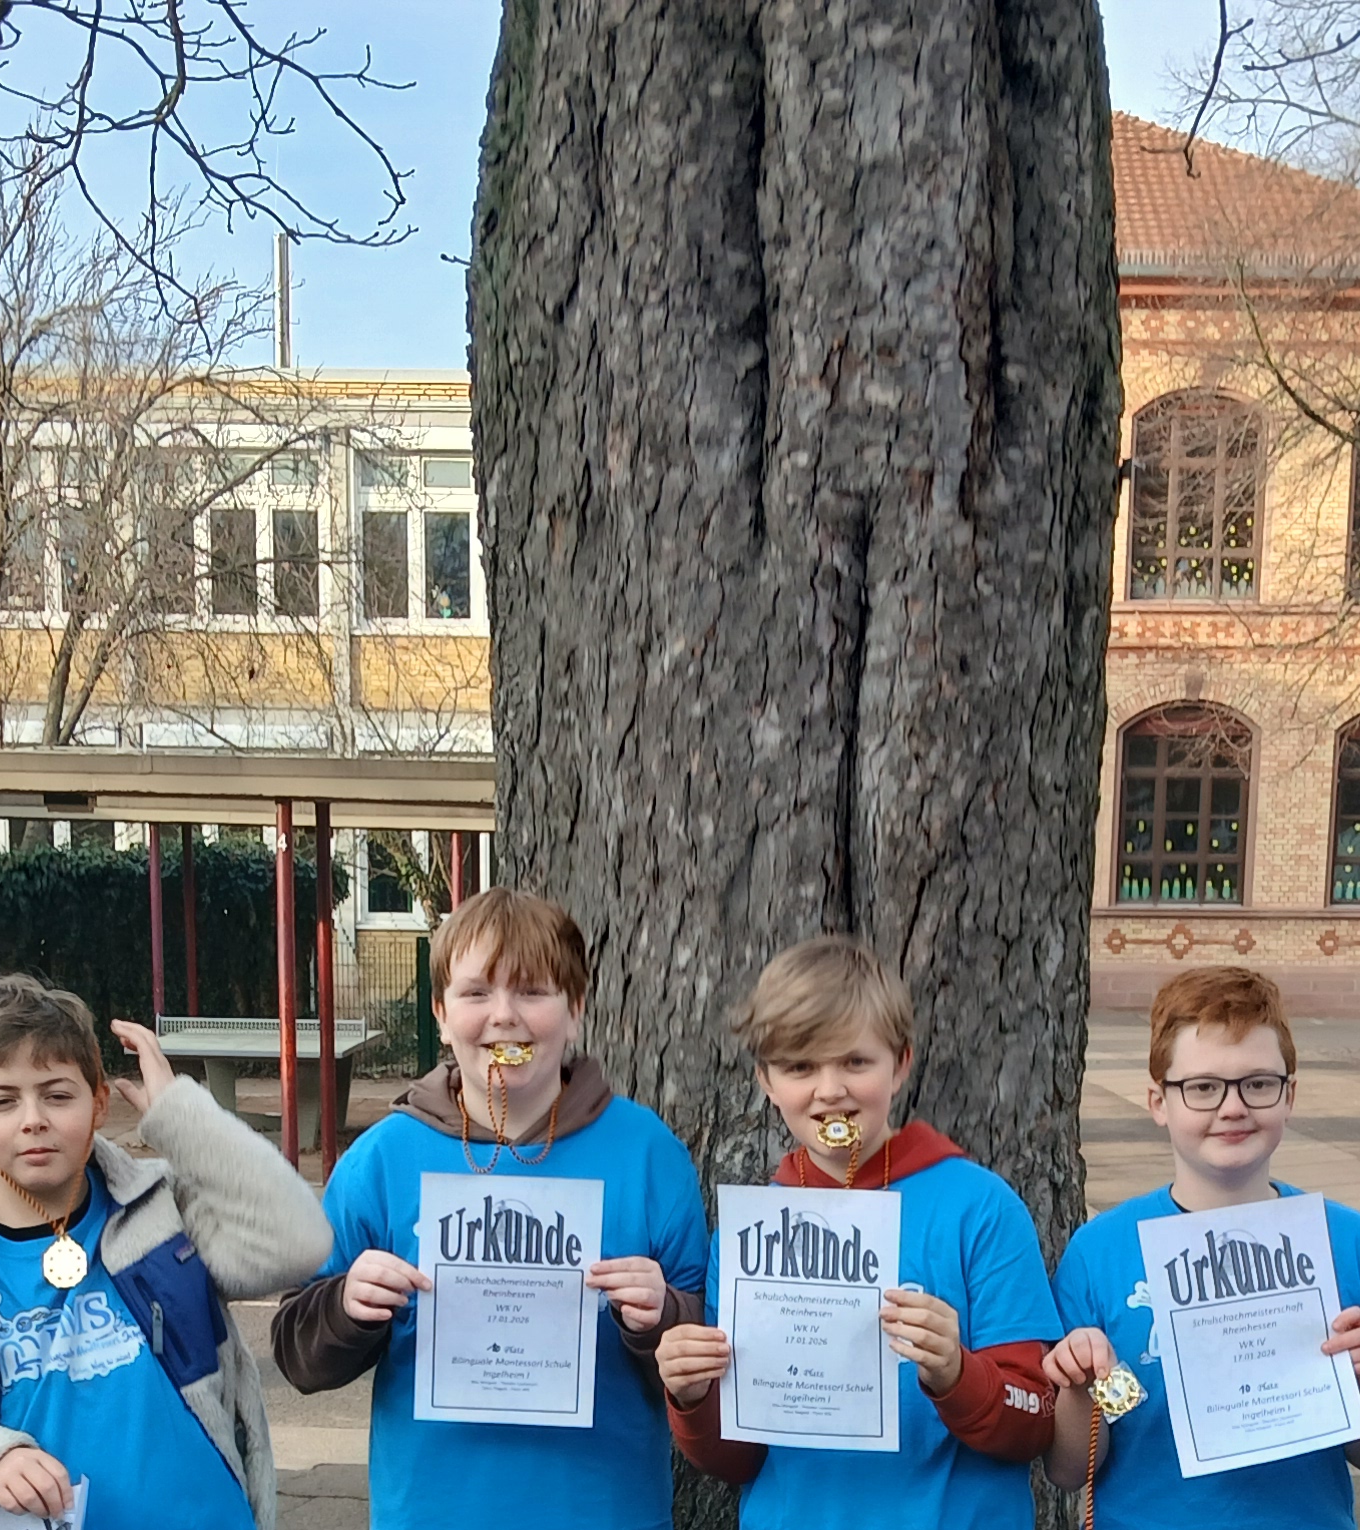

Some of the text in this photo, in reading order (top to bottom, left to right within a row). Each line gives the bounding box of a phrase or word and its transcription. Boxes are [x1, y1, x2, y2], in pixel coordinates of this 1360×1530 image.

[277, 832, 288, 852] 4
[439, 1194, 583, 1266] Urkunde
[737, 1206, 880, 1284] Urkunde
[1164, 1229, 1316, 1306] Urkunde
[46, 1296, 112, 1341] MS
[779, 1307, 833, 1318] Rheinhessen
[1192, 1302, 1304, 1328] Schulschachmeisterschaft
[793, 1324, 820, 1334] WK IV
[1222, 1320, 1277, 1336] Rheinhessen
[1239, 1337, 1267, 1349] WK IV
[495, 1357, 543, 1368] Montessori
[544, 1359, 572, 1369] Schule
[483, 1369, 525, 1380] Ingelheim
[795, 1380, 844, 1392] Montessori
[845, 1383, 874, 1393] Schule
[1251, 1389, 1302, 1406] Montessori
[1302, 1383, 1332, 1397] Schule
[784, 1393, 826, 1405] Ingelheim
[1241, 1405, 1286, 1421] Ingelheim
